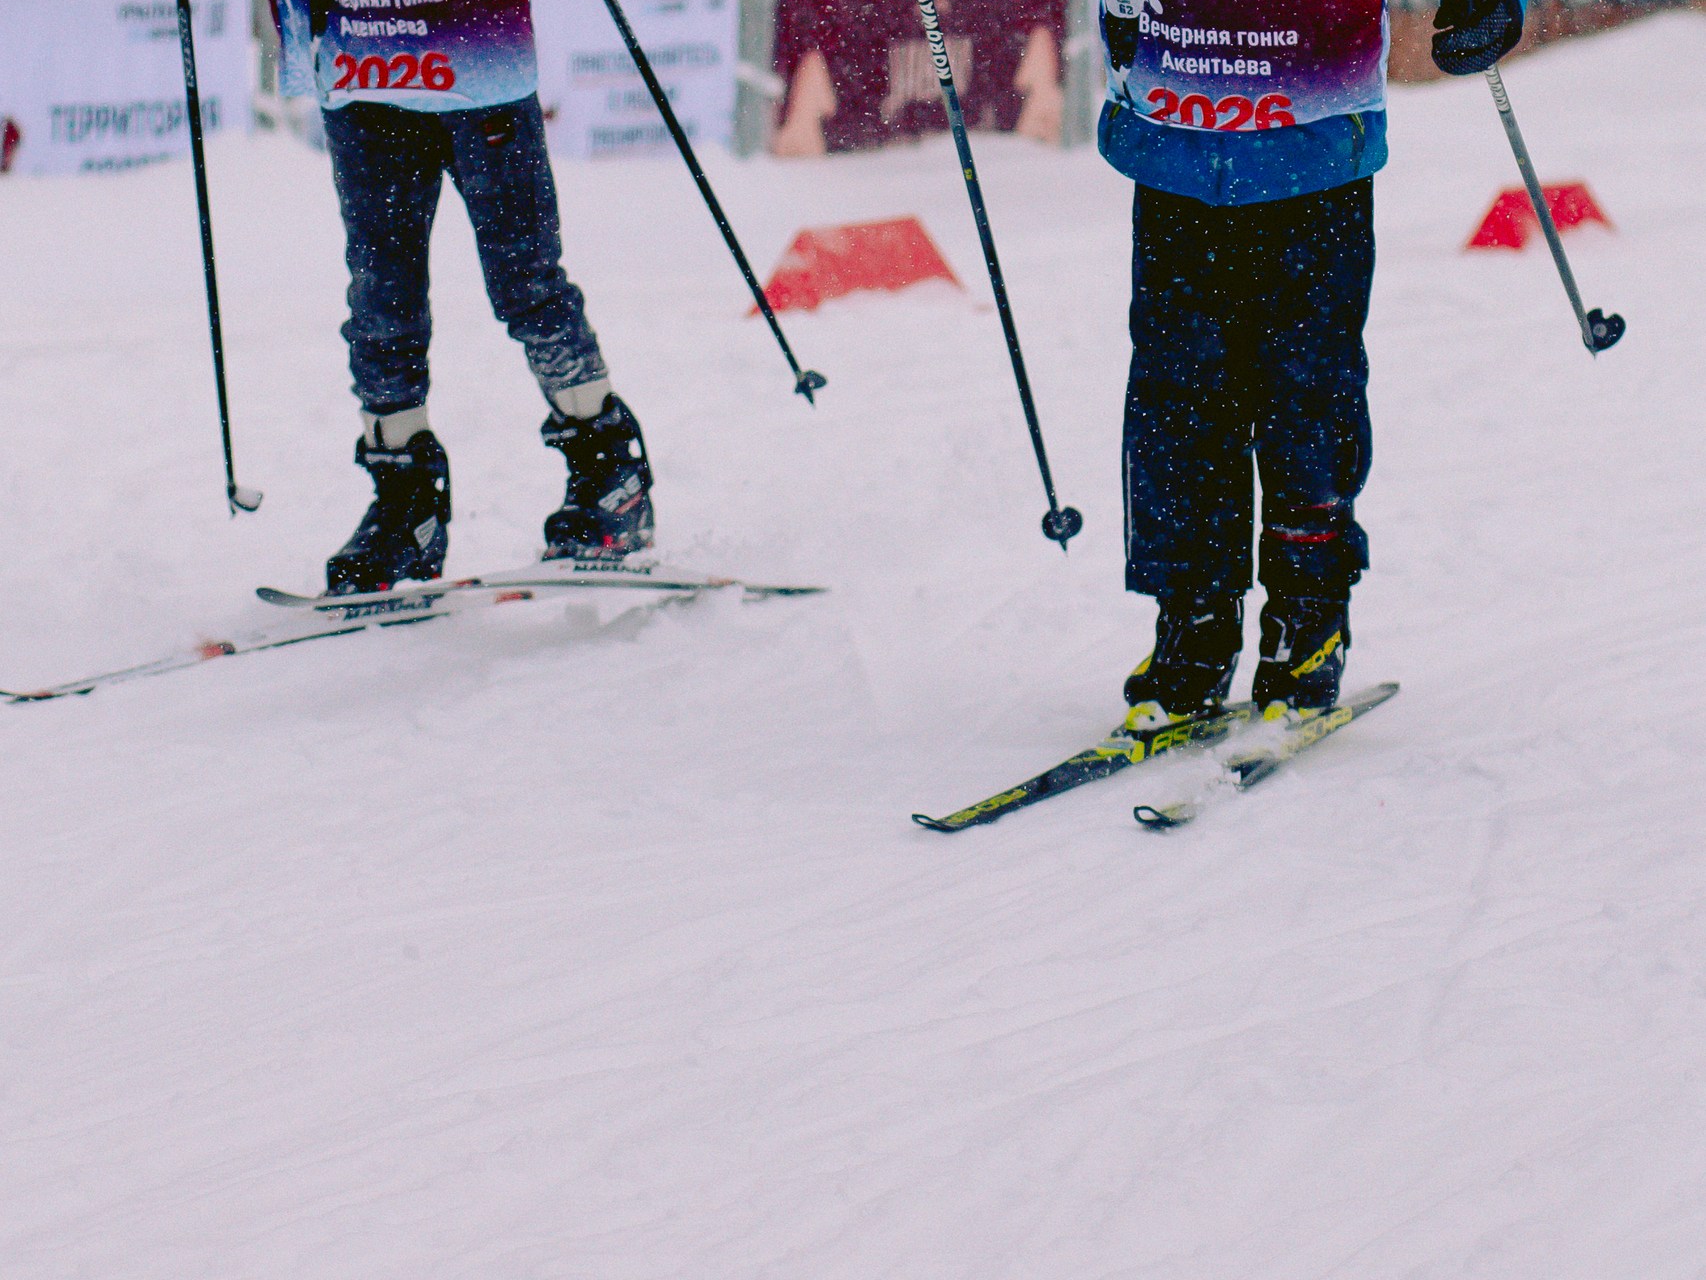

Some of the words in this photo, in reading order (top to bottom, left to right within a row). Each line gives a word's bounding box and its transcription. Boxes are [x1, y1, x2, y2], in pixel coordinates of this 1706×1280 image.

[1139, 12, 1231, 48] Вечерняя
[1237, 29, 1299, 47] гонка
[333, 51, 456, 91] 2026
[1162, 50, 1272, 76] Акентьева
[50, 97, 220, 143] ТЕРРИТОРЯ
[1147, 87, 1296, 132] 2026
